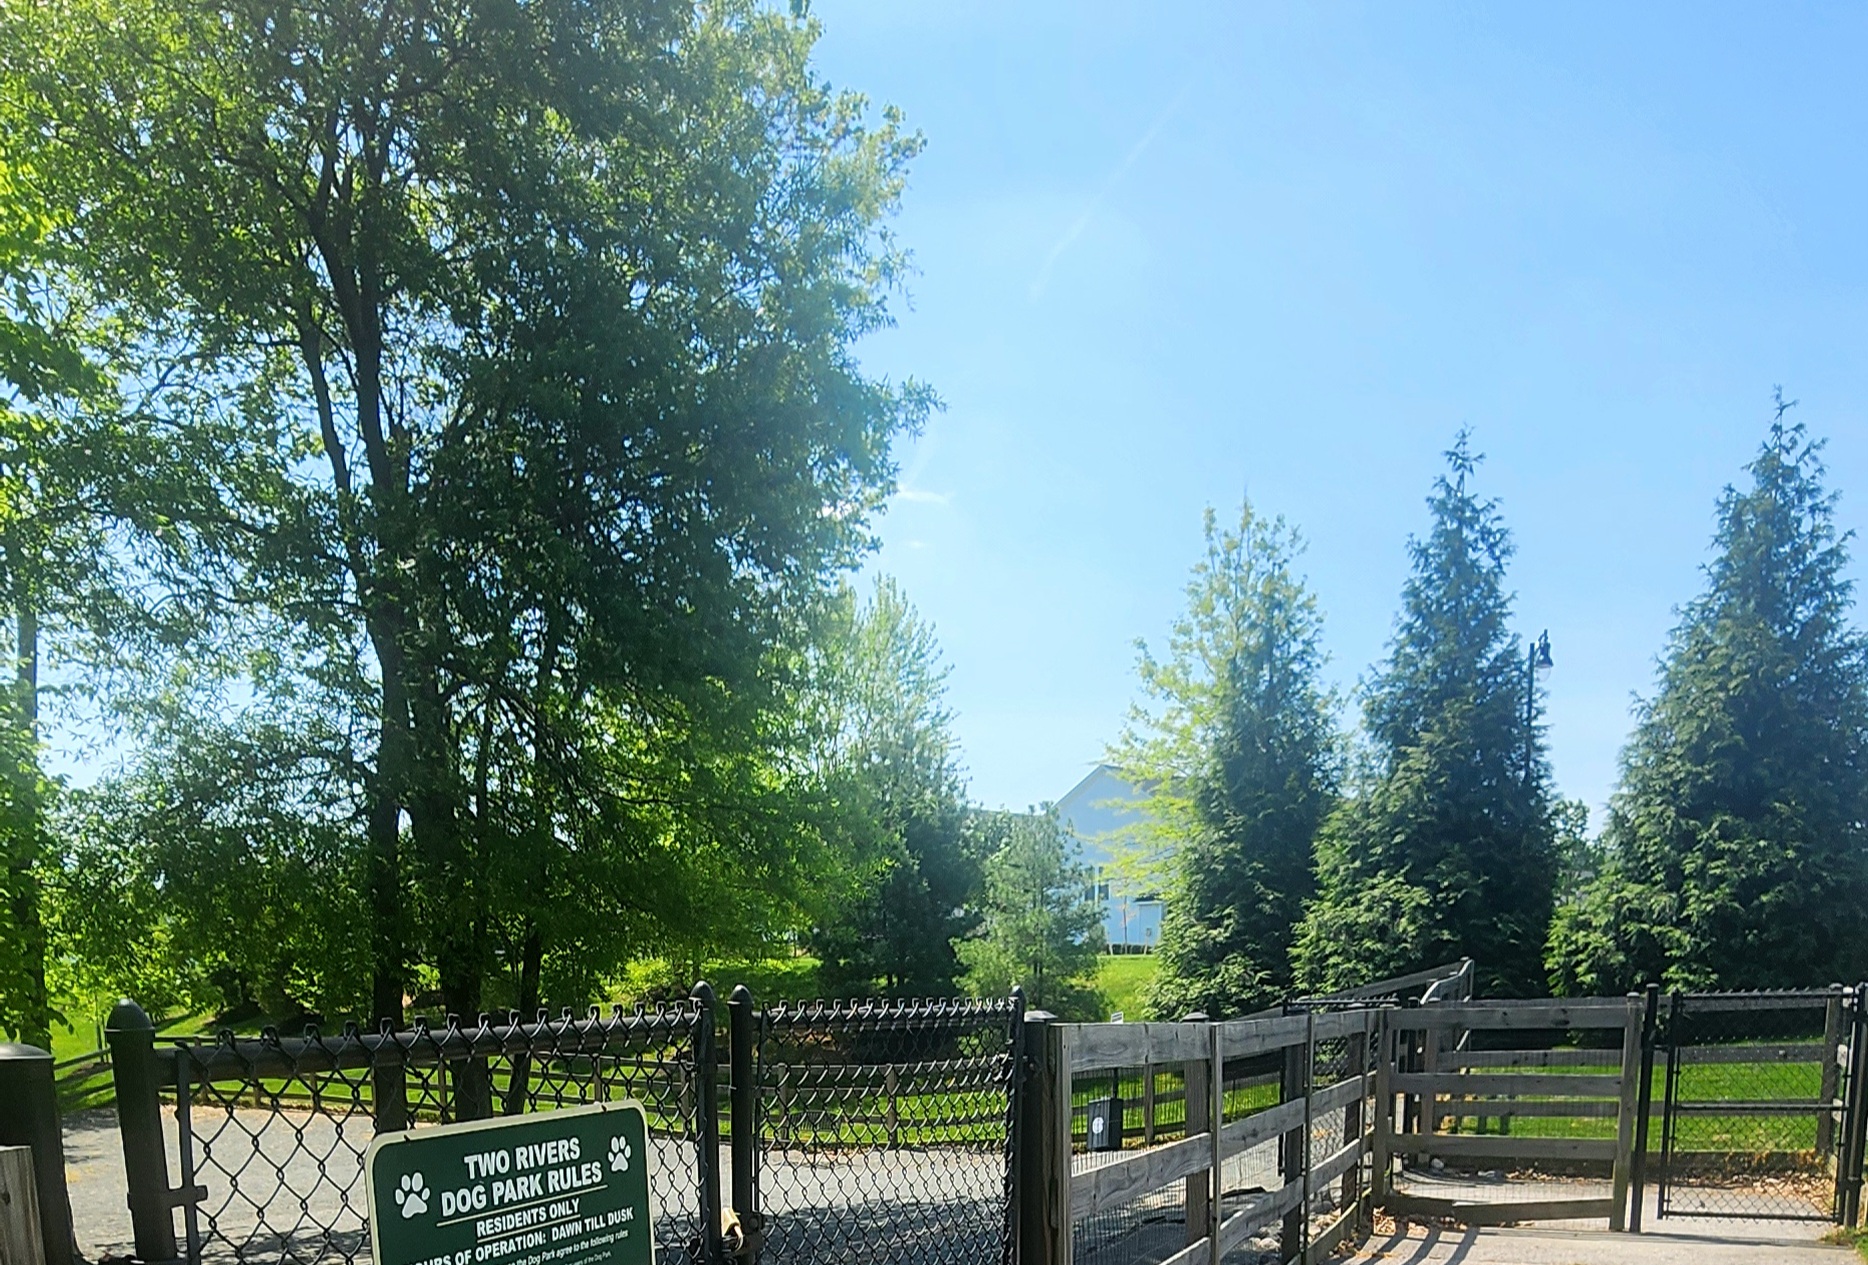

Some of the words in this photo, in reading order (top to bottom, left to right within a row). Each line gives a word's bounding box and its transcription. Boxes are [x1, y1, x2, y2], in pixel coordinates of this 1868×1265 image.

[465, 1149, 510, 1180] TWO
[516, 1137, 580, 1171] RIVERS
[441, 1185, 487, 1217] DOG
[492, 1173, 542, 1206] PARK
[548, 1161, 602, 1193] RULES
[476, 1230, 546, 1262] OPERATION:
[552, 1220, 582, 1241] DAWN
[585, 1214, 606, 1232] TILL
[608, 1207, 633, 1226] DUSK
[477, 1206, 546, 1238] RESIDENTS
[549, 1198, 579, 1219] ONLY
[541, 1249, 555, 1262] Park
[556, 1246, 573, 1259] agree
[573, 1243, 580, 1252] to
[580, 1240, 589, 1250] the
[590, 1232, 615, 1249] following
[615, 1228, 629, 1240] rules
